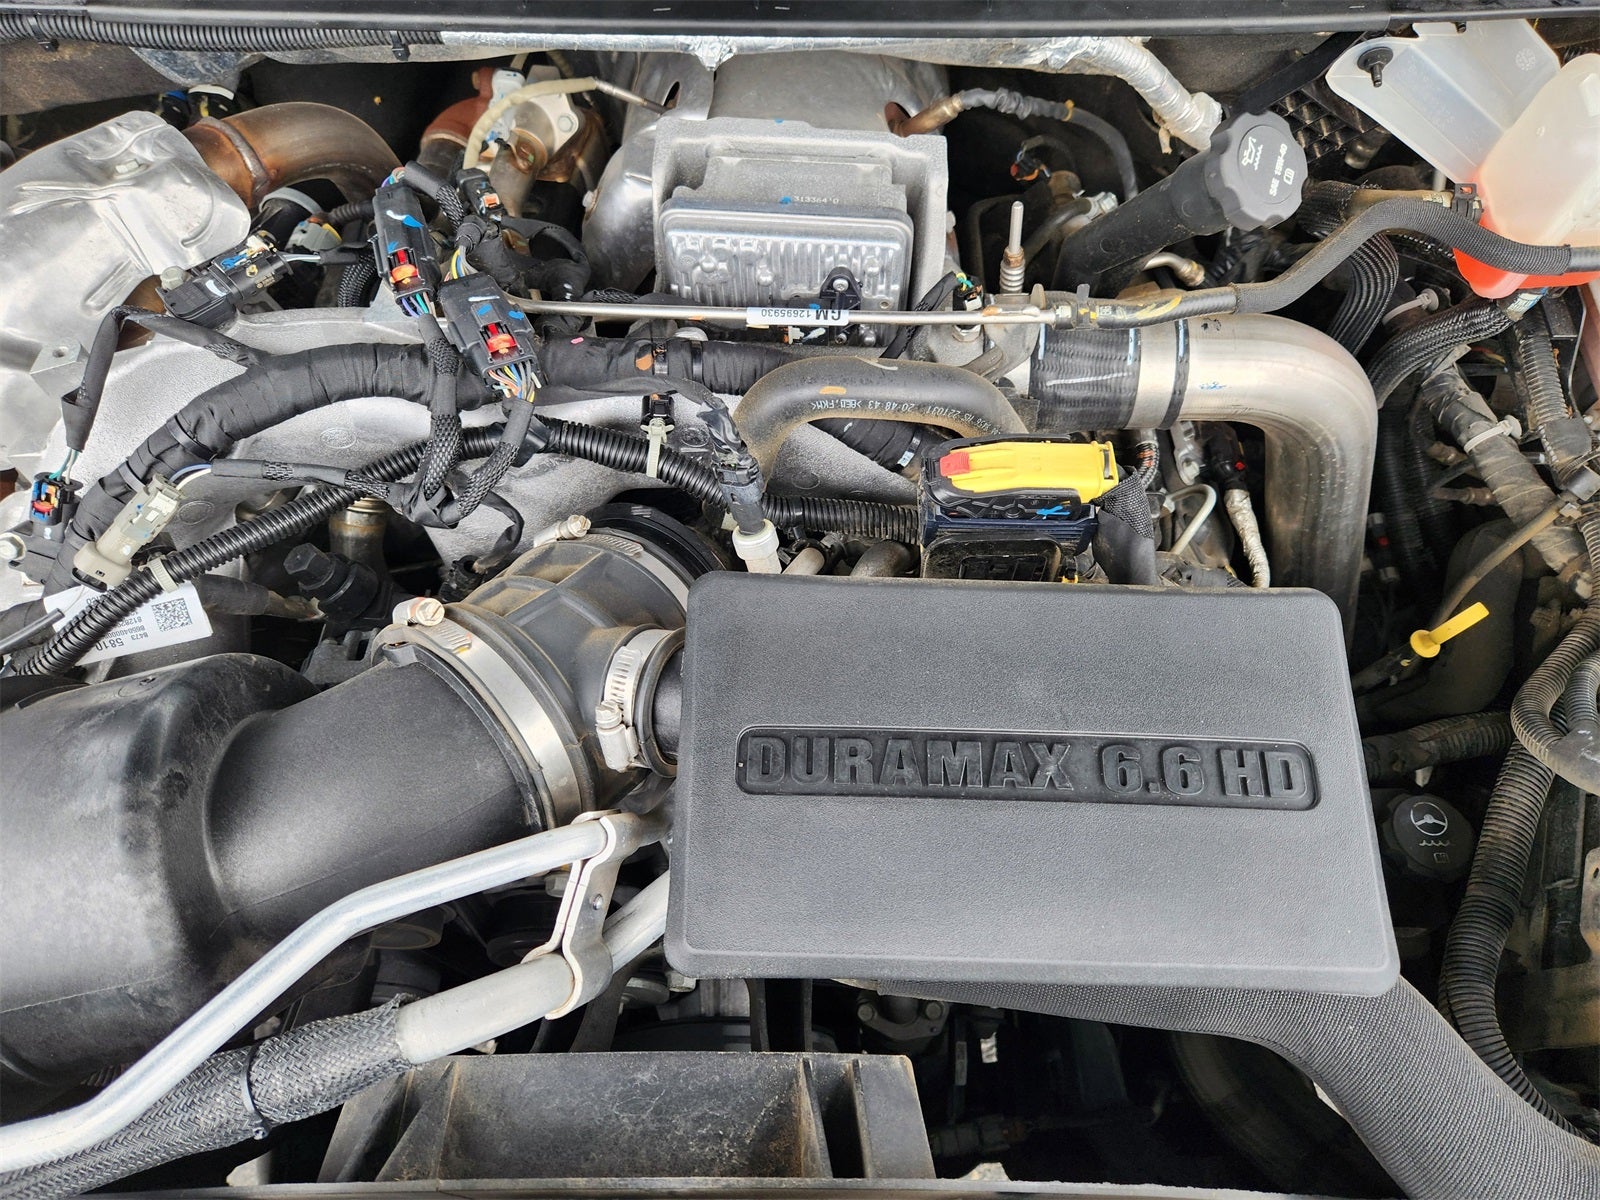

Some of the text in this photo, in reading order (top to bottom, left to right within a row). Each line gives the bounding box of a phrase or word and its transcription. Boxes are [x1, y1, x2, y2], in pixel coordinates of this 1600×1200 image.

[1269, 143, 1288, 197] SAE 15W-40
[761, 308, 841, 320] GM 12695930
[746, 735, 1307, 798] DURAMAX 6.6 HD
